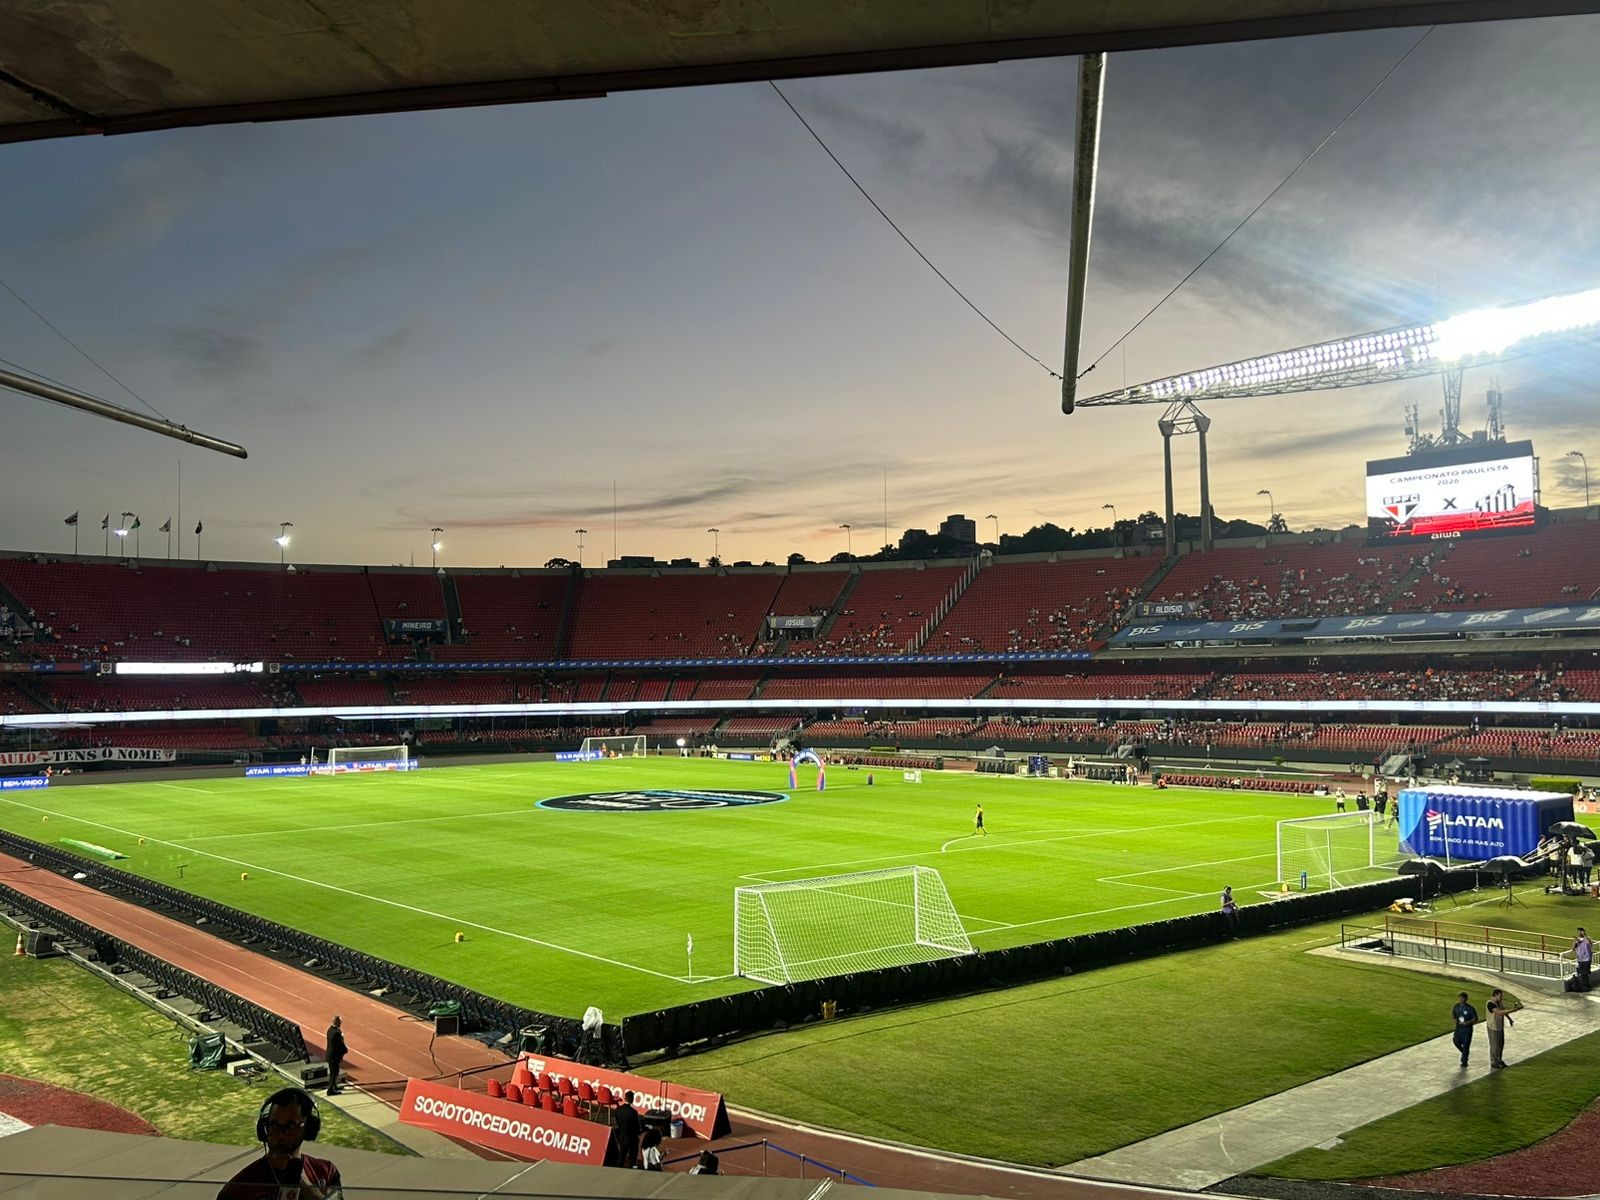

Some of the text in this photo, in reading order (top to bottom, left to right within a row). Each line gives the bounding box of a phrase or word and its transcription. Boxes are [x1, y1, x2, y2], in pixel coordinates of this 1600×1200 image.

[1390, 464, 1510, 484] CAMPEONATO PAULISTA
[1383, 493, 1420, 505] SPFC
[52, 750, 97, 762] TENS
[117, 748, 161, 760] NOME
[3, 778, 43, 787] BEM-VINDO
[1445, 814, 1504, 829] LATAM
[1429, 835, 1462, 843] BEM-INDO
[414, 1095, 591, 1156] SOCIOTORCEDOR.COM.BR
